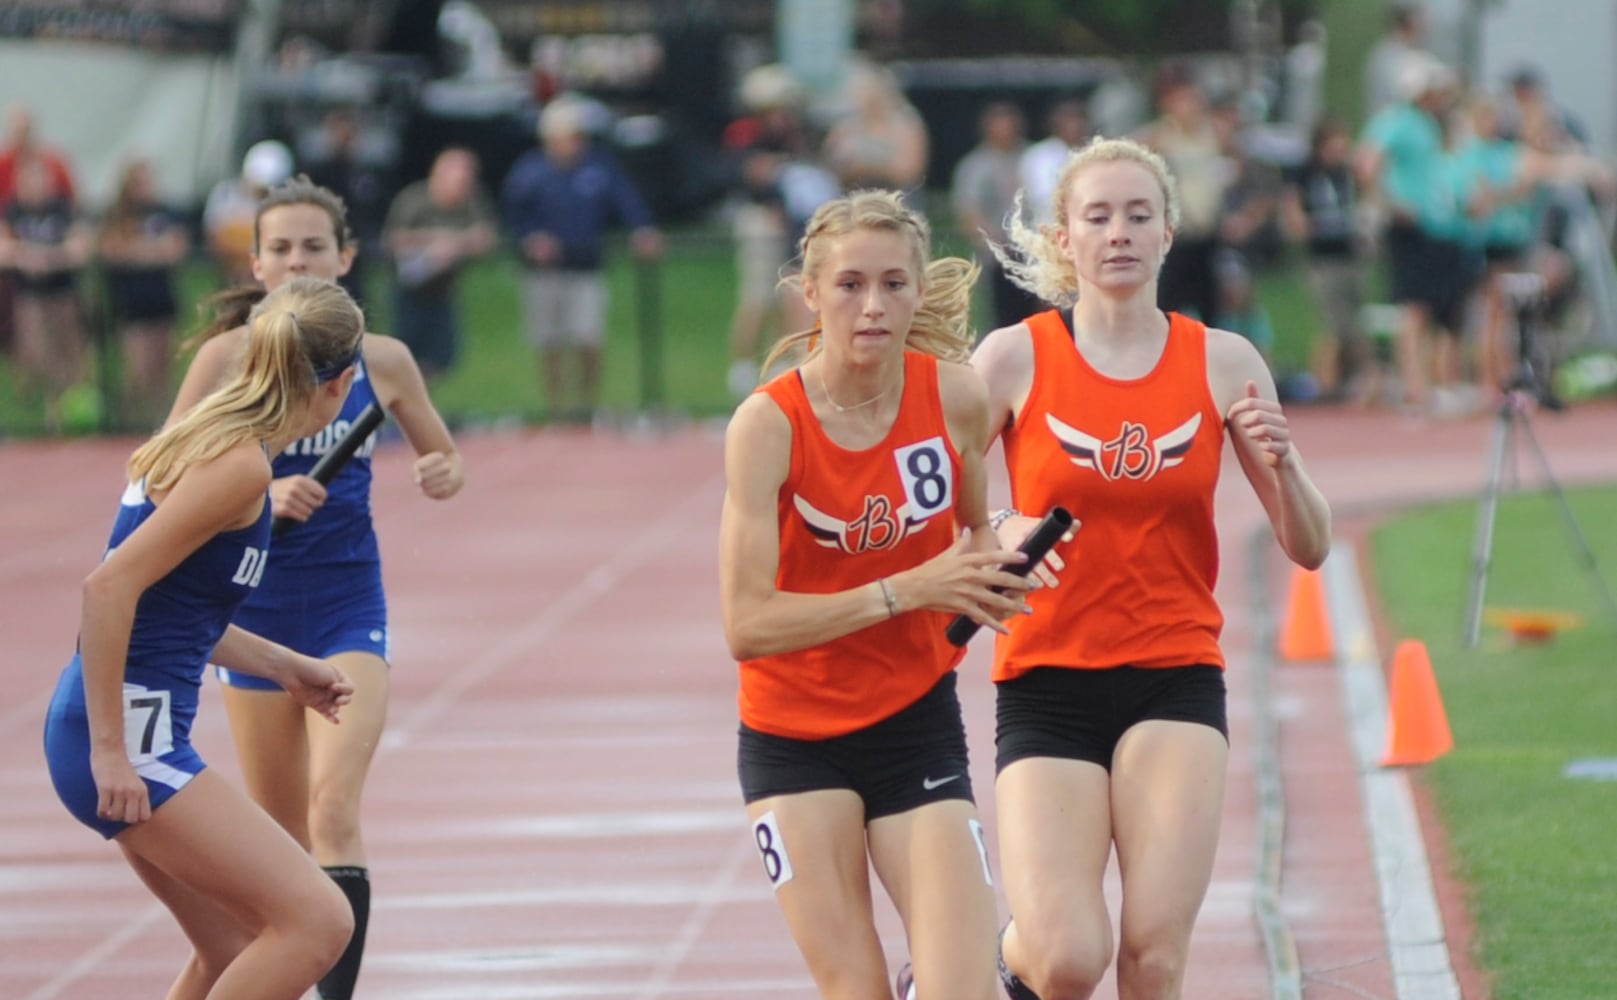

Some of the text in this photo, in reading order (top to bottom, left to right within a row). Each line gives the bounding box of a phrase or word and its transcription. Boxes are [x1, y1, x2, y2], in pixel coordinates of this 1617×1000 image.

[907, 447, 946, 510] 8
[1102, 421, 1151, 480] B
[848, 494, 897, 553] B
[130, 697, 163, 754] 7
[756, 823, 782, 883] 8
